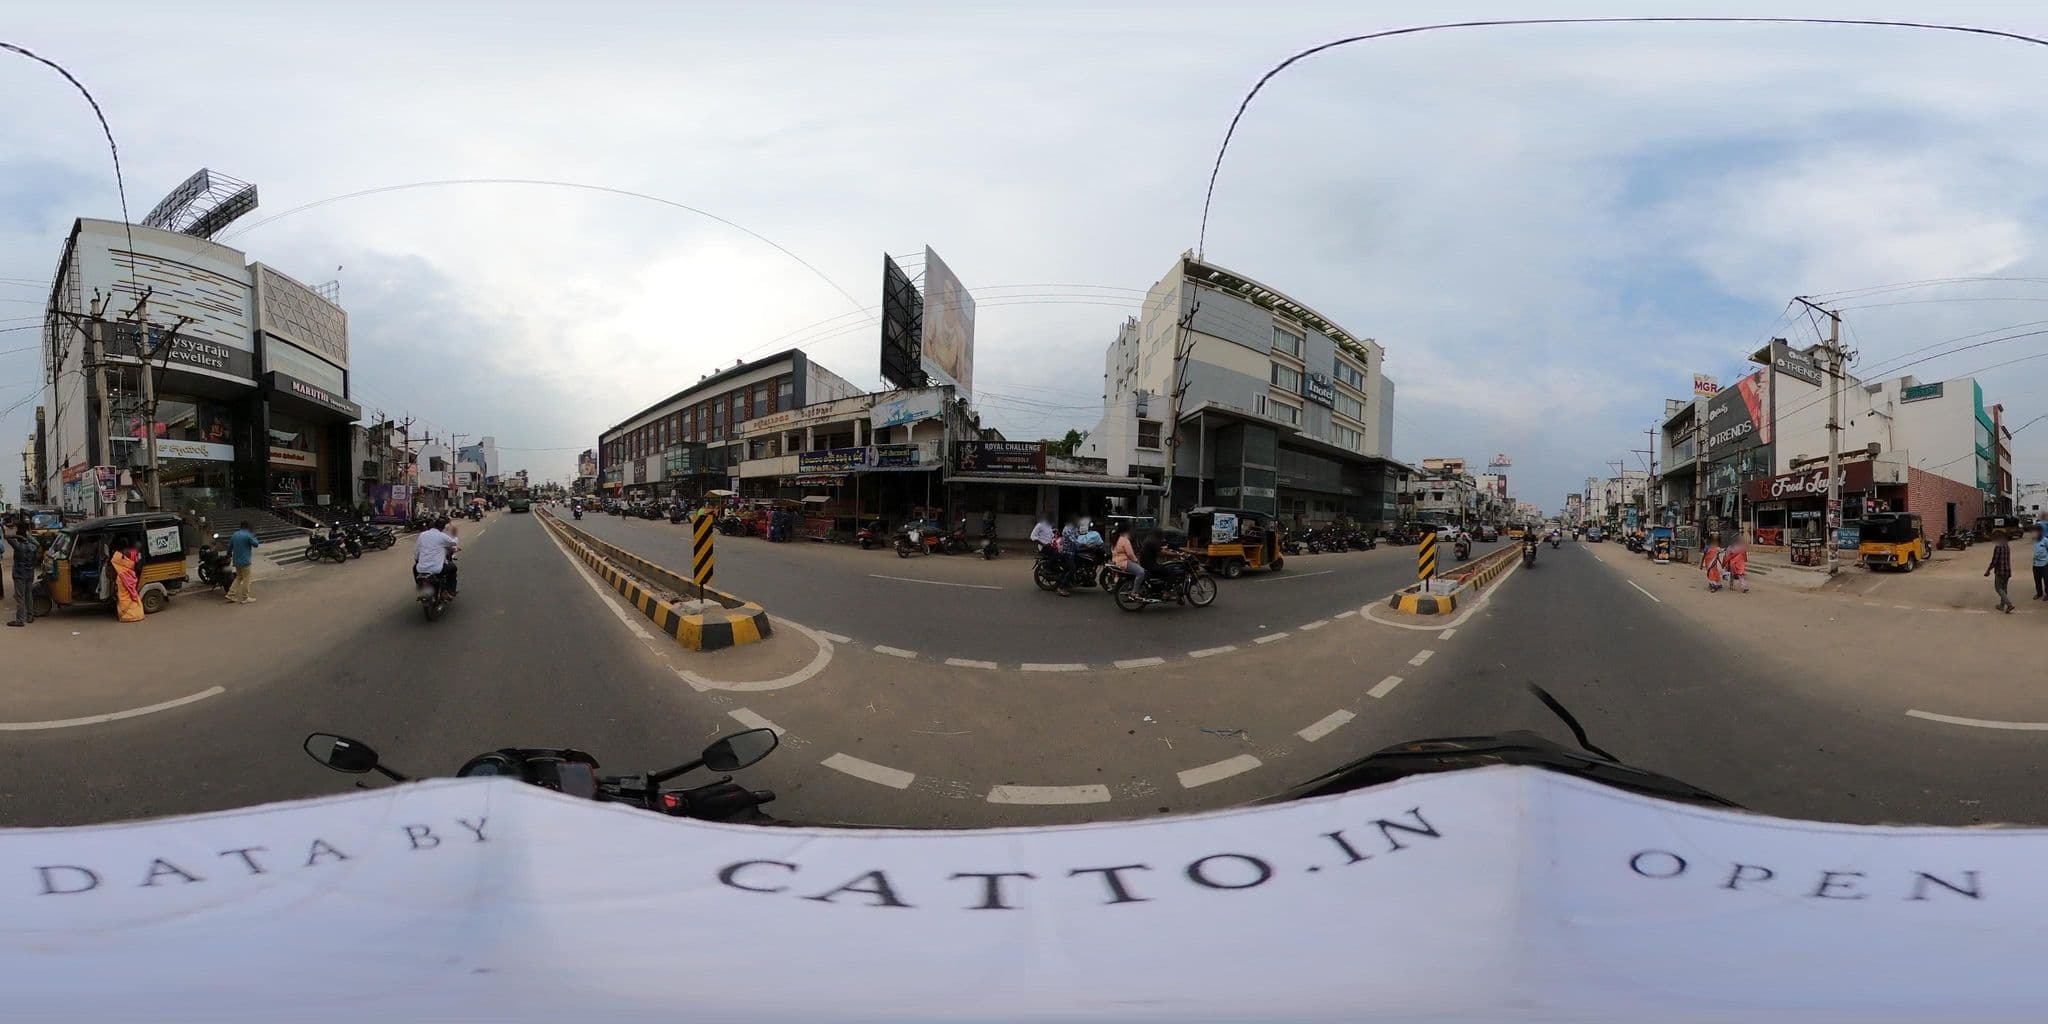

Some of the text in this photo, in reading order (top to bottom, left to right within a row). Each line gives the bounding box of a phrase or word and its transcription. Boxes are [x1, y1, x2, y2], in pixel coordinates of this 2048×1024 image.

[1786, 361, 1822, 382] TRENDS
[292, 381, 329, 402] MARUTHI
[1695, 381, 1717, 393] MGR
[1717, 420, 1752, 445] TRENDS
[985, 443, 1041, 452] ROYAL CHALLENGE
[1771, 476, 1805, 497] Food
[34, 815, 490, 896] DATA BY
[717, 807, 1443, 911] CATTO.IN
[1628, 849, 1984, 901] OPEN
